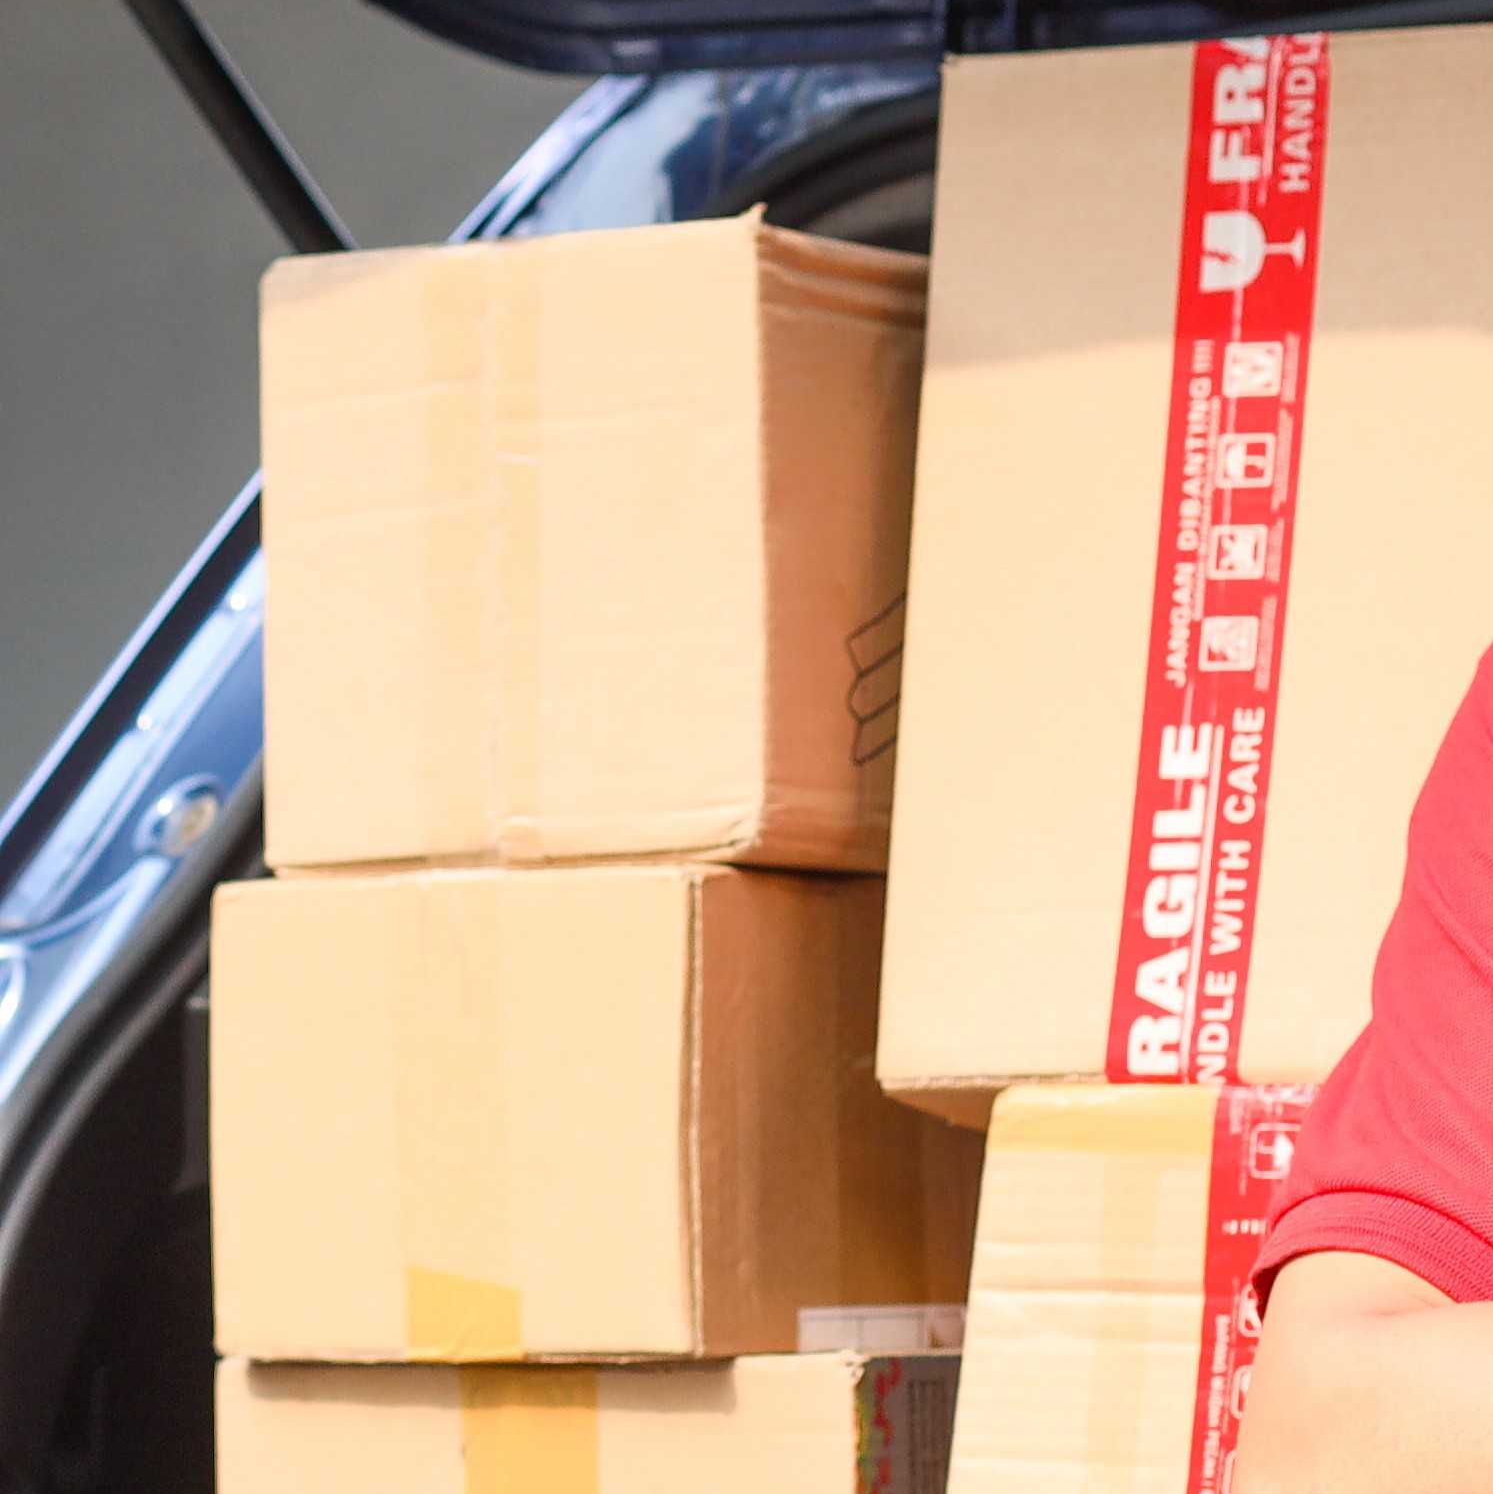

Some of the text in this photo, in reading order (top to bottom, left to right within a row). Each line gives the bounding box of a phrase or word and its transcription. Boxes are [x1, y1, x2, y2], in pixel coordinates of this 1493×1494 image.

[1165, 562, 1196, 688] JANGAN
[1222, 706, 1266, 825] CARE
[1208, 840, 1253, 956] WITH
